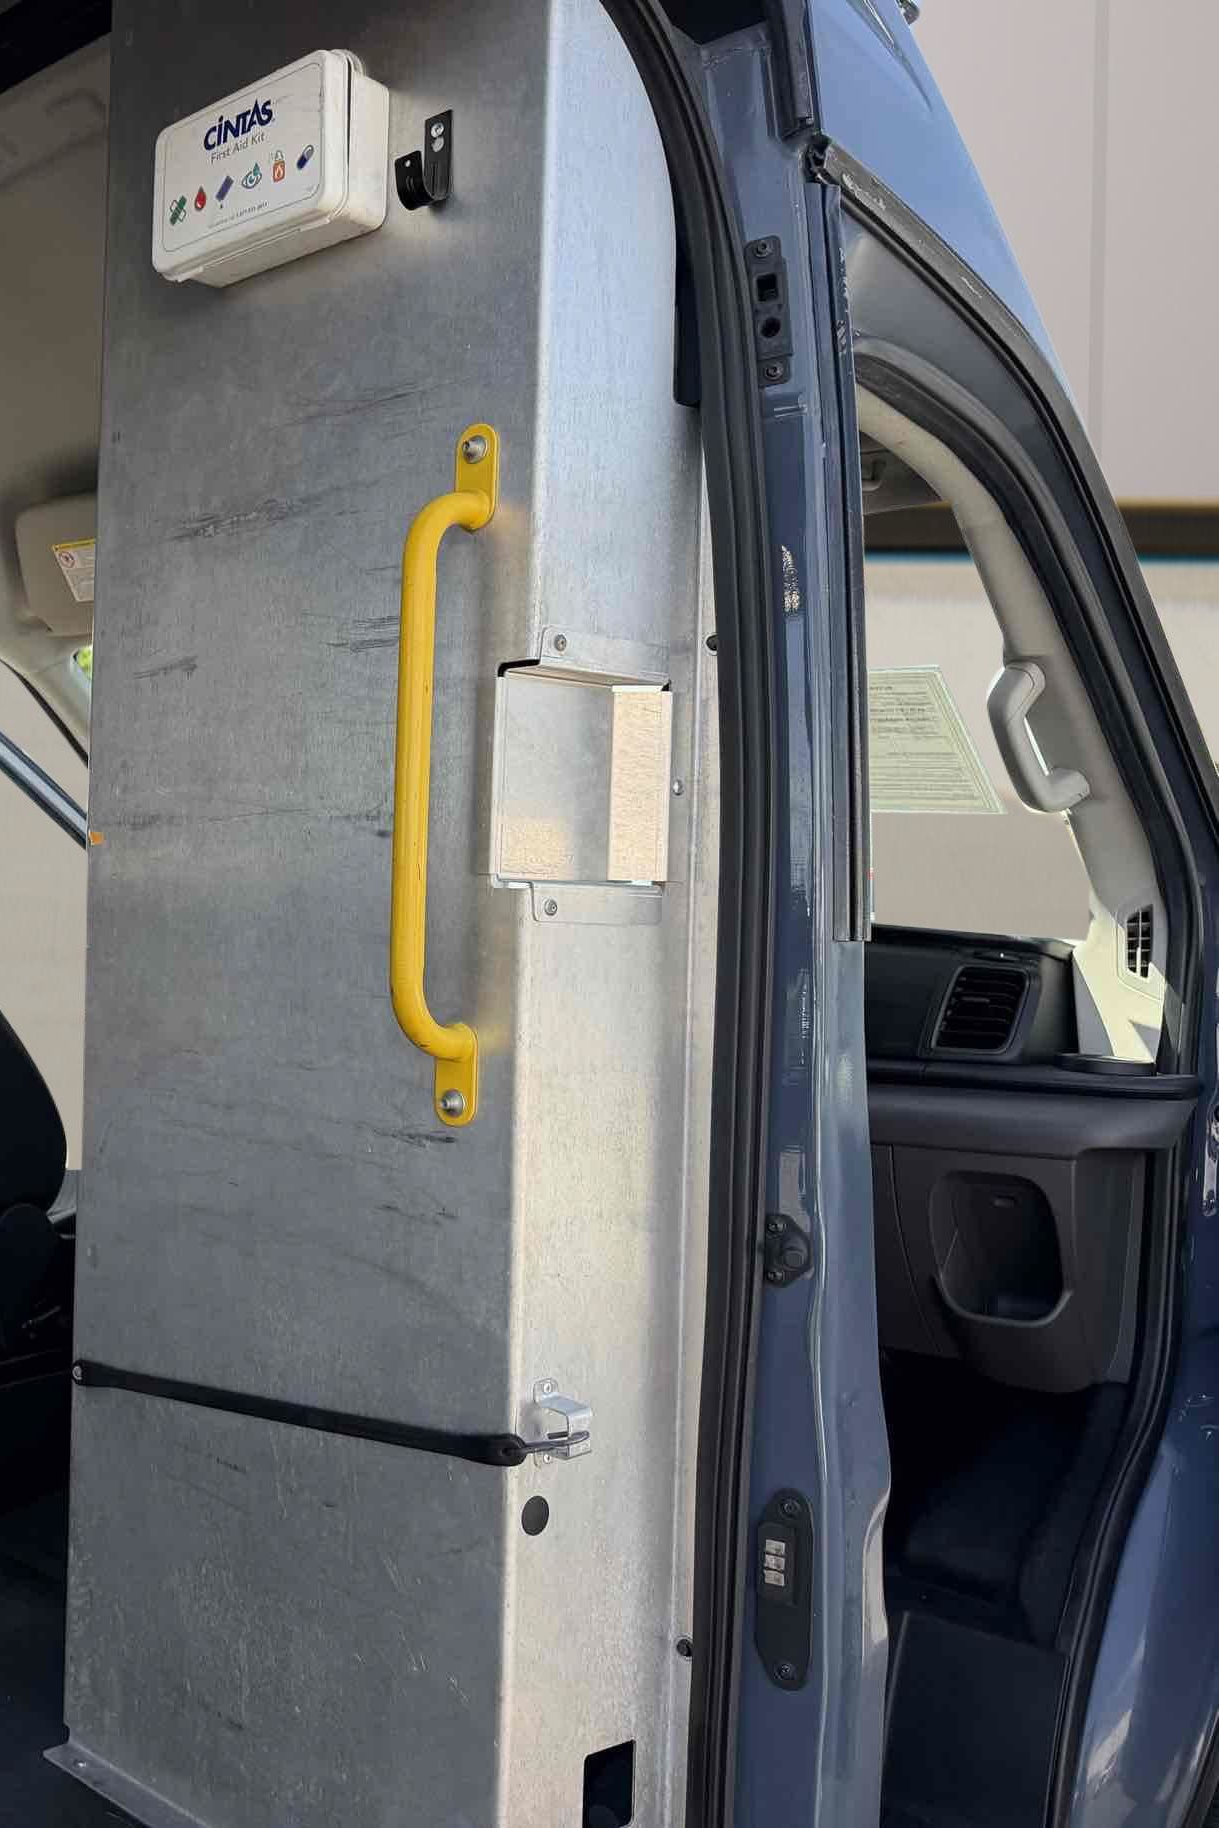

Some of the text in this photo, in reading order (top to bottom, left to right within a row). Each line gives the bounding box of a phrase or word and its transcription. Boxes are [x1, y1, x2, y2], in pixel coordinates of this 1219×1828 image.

[210, 132, 266, 165] First Aid Kit
